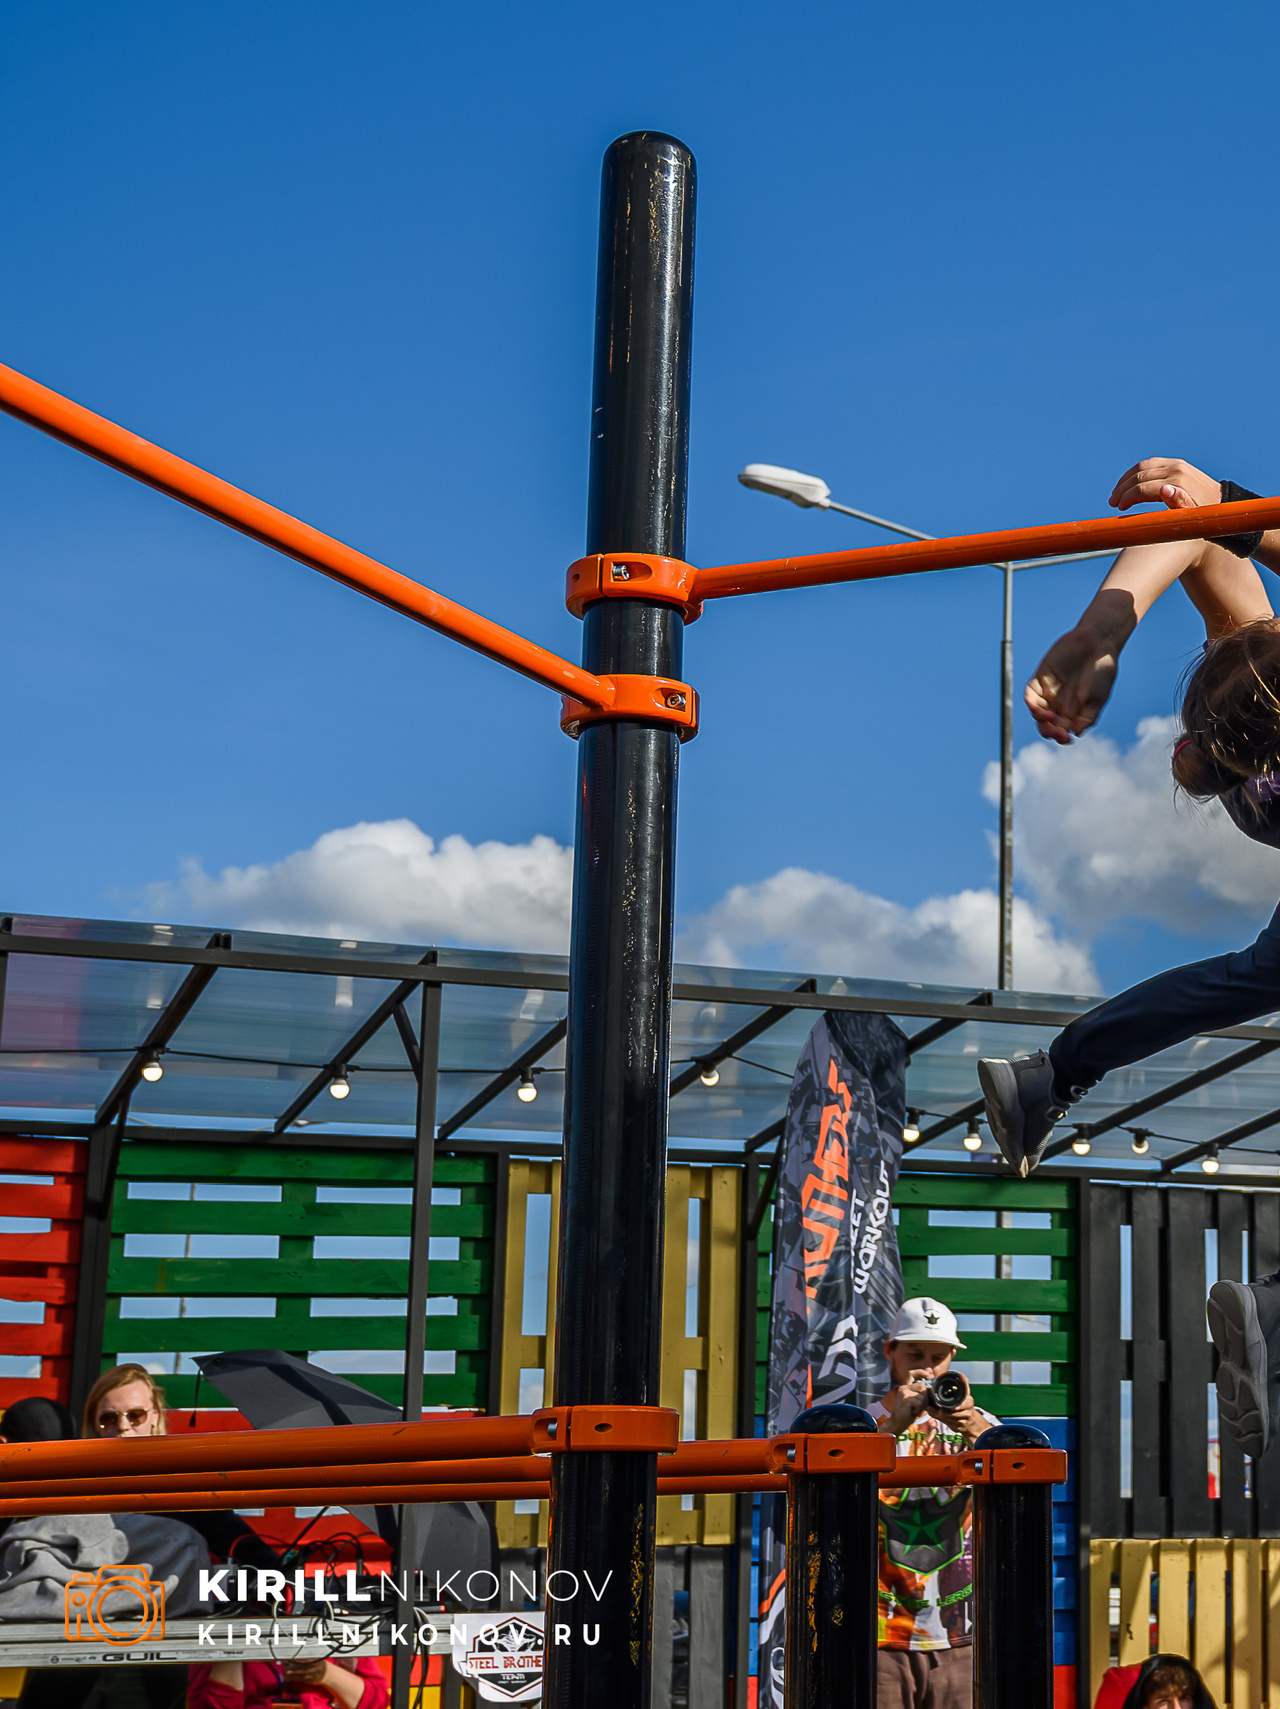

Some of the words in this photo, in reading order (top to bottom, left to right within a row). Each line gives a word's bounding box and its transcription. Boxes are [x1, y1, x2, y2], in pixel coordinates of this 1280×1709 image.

[853, 1159, 889, 1294] WORKOUT
[102, 1651, 177, 1663] GUIL
[469, 1657, 499, 1669] STEEL
